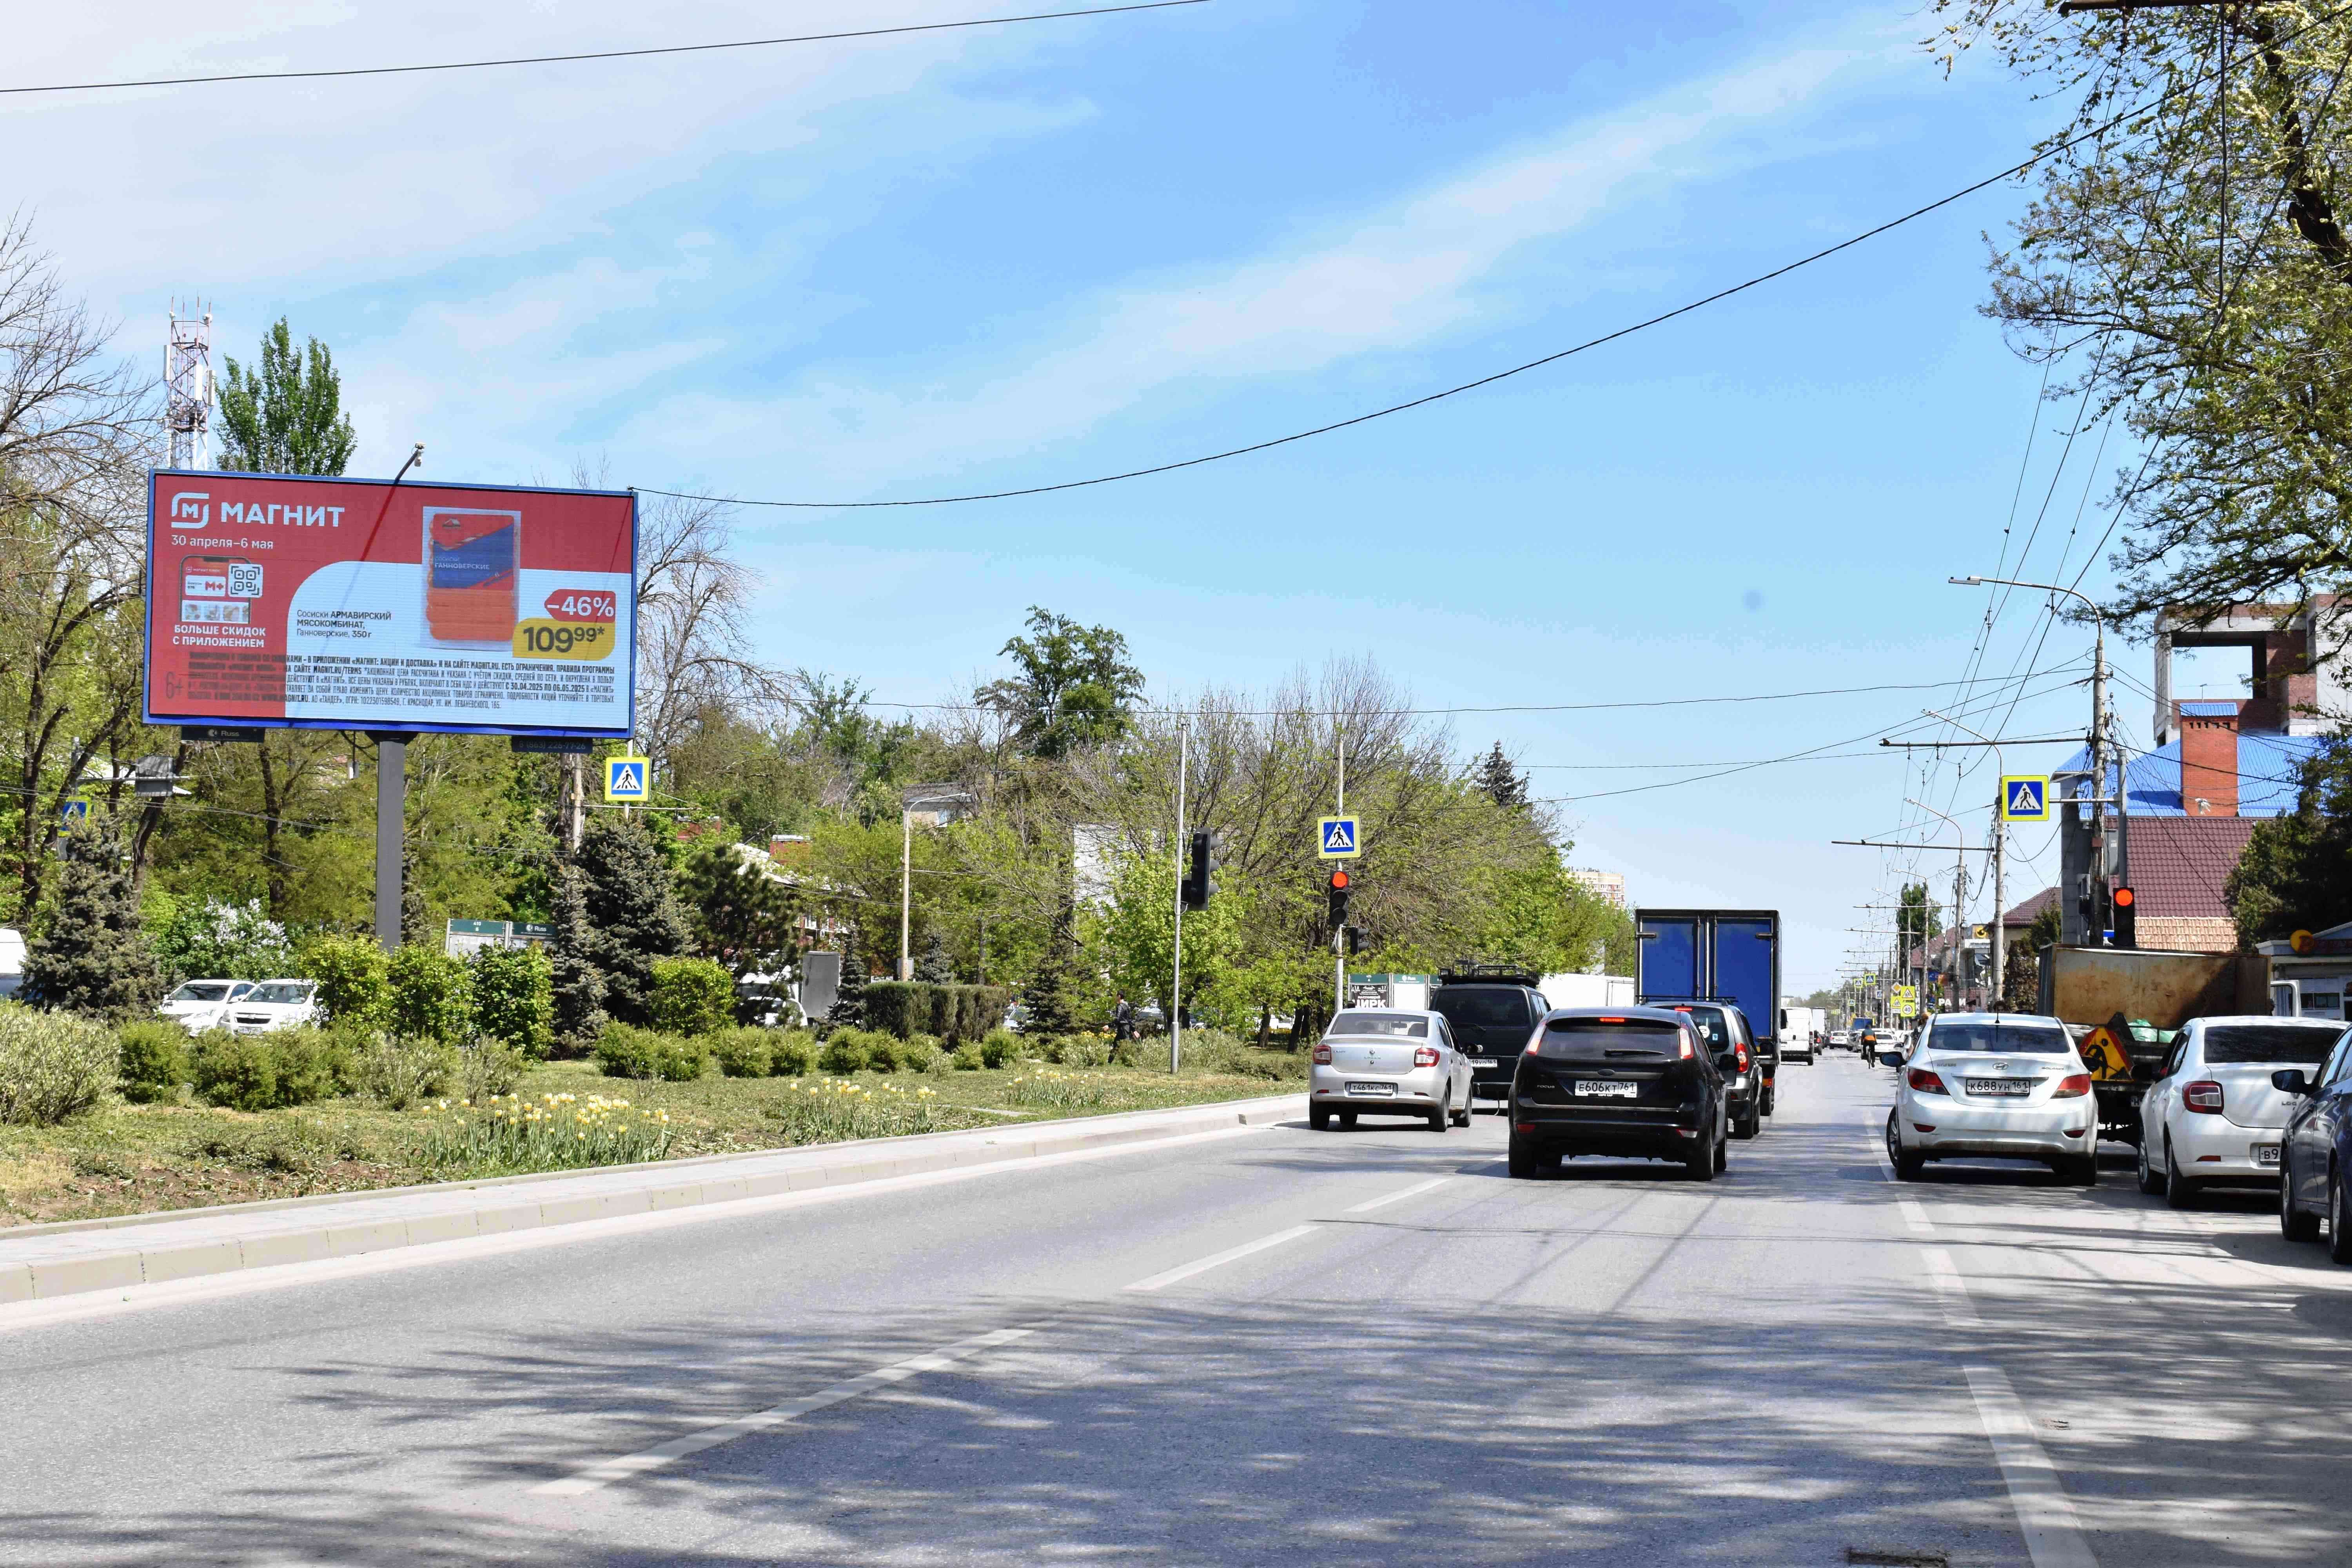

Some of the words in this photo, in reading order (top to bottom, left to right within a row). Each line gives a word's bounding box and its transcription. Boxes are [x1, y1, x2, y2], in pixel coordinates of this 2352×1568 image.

[221, 502, 345, 527] МАГНИТ
[171, 535, 186, 546] 30
[251, 540, 274, 549] мая
[330, 611, 391, 621] АРМАВИРСКИЙ
[174, 624, 219, 636] БОЛЬШЕ
[222, 626, 266, 637] СКИДОК
[297, 619, 365, 629] МЯСОКОМБИНАТ,
[297, 628, 350, 638] Ганноверские,
[172, 636, 180, 645] С
[182, 636, 264, 648] ПРИЛОЖЕНИЕМ
[313, 655, 350, 664] ПРИЛОЖЕНИИ
[381, 658, 399, 667] АКЦИИ
[406, 659, 437, 668] ДОСТАВКА»
[444, 660, 451, 668] НА
[453, 659, 470, 669] САЙТЕ
[516, 663, 555, 672] ОГРАНИЧЕНИЯ.
[556, 664, 581, 673] ПРАВИЛА
[582, 666, 615, 674] ПРОГРАММЫ
[294, 664, 311, 673] САЙТЕ
[397, 668, 409, 677] ЦЕНА
[411, 669, 439, 677] РАССЧИТАНА
[515, 672, 535, 682] СРЕДНЕЙ
[565, 675, 590, 683] ОКРУГЛЕНА
[597, 675, 615, 684] ПОЛЬЗУ
[358, 677, 371, 686] ЦЕНЫ
[419, 679, 445, 687] ВКЛЮЧАЮТ
[463, 681, 472, 690] НДС
[477, 681, 504, 690] ДЕЙСТВУЮТ
[510, 682, 543, 691] 30.04.2025
[553, 684, 585, 692] 06.05.2025
[316, 684, 331, 693] СОБОЙ
[333, 686, 347, 694] ПРАВО
[350, 686, 374, 695] ИЗМЕНИТЬ
[391, 688, 420, 696] КОЛИЧЕСТВО
[422, 689, 451, 698] АКЦИОННЫХ
[453, 690, 473, 698] ТОВАРОВ
[507, 691, 539, 701] ПОДРОБНОСТИ
[541, 692, 556, 702] АКЦИЙ
[559, 693, 584, 702] УТОЧНЯЙТЕ
[591, 695, 614, 703] ТОРГОВЫХ
